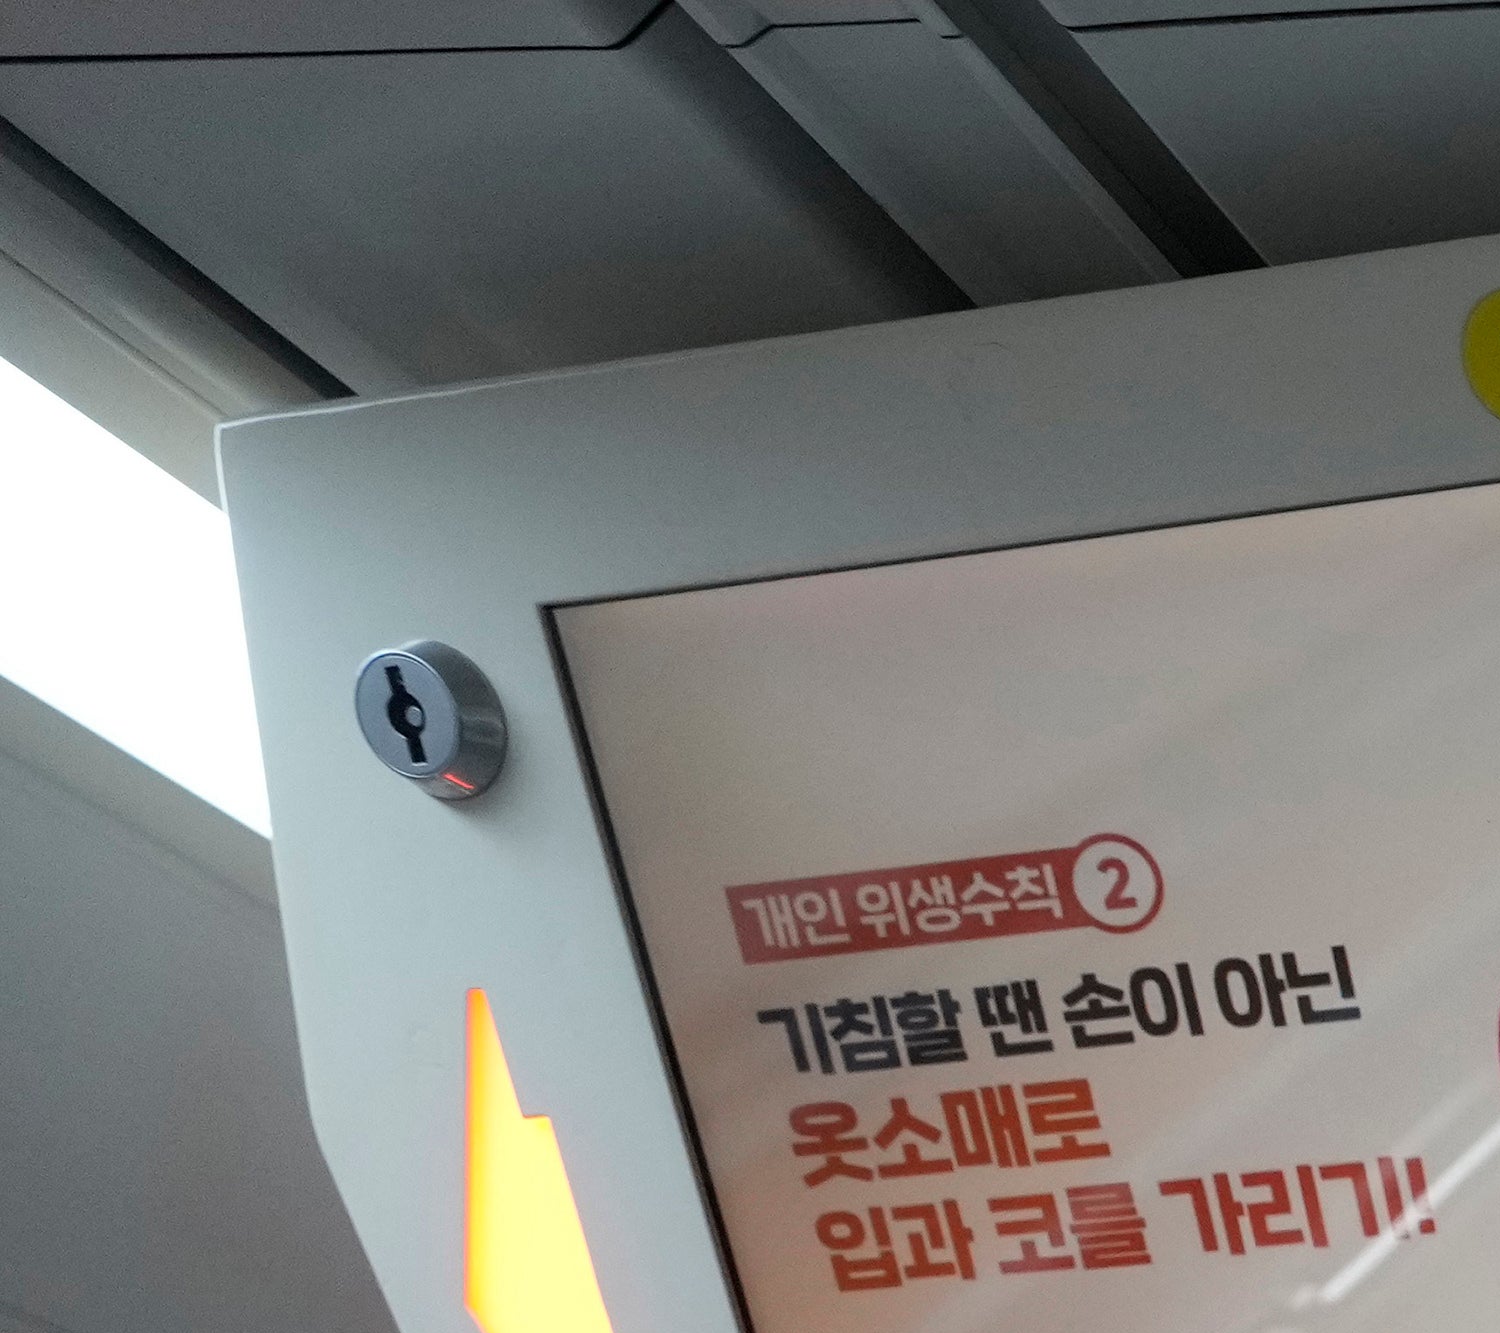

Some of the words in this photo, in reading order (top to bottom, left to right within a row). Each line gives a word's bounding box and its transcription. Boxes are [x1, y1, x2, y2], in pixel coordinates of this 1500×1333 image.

[743, 889, 850, 950] 개인
[857, 863, 1063, 939] 위생수칙
[757, 987, 969, 1075] 기침할
[972, 979, 1054, 1058] 땐
[1062, 964, 1204, 1048] 손이
[1214, 945, 1361, 1027] 아닌
[787, 1078, 1111, 1188] 옷소매로
[815, 1199, 976, 1293] 입과
[988, 1182, 1152, 1273] 코를
[1159, 1156, 1437, 1255] 가리기!
